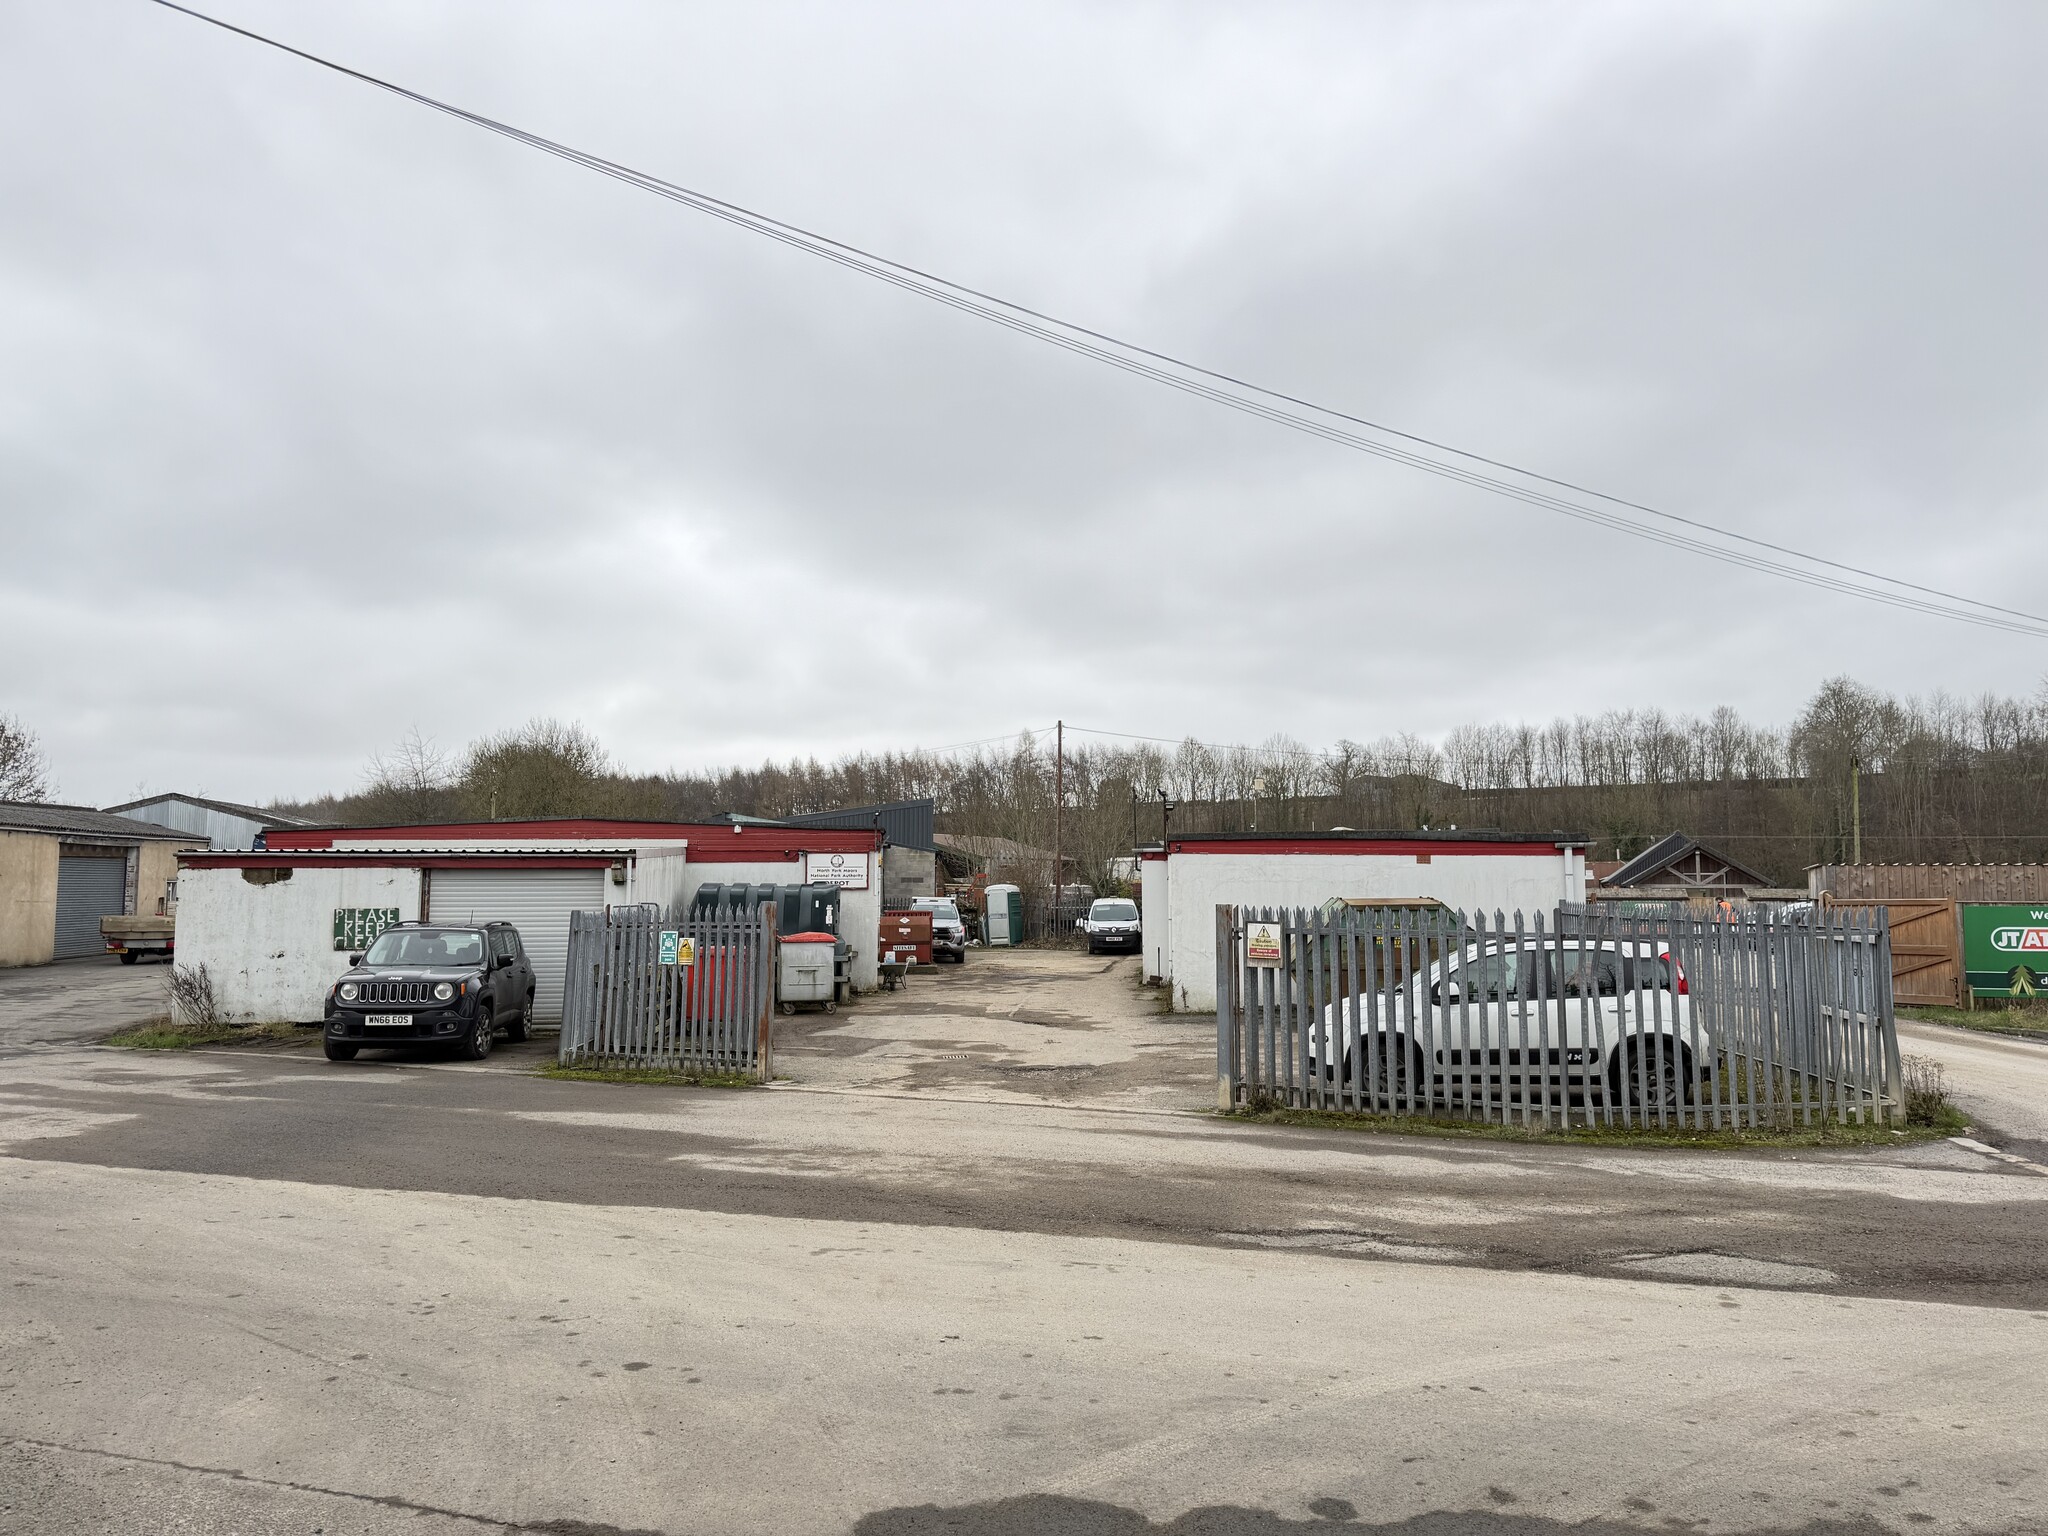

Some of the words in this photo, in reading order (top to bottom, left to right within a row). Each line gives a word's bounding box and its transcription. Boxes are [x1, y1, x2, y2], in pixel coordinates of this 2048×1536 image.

[335, 909, 396, 924] PLEASE
[344, 922, 386, 936] KEEP
[334, 936, 374, 950] CLEA
